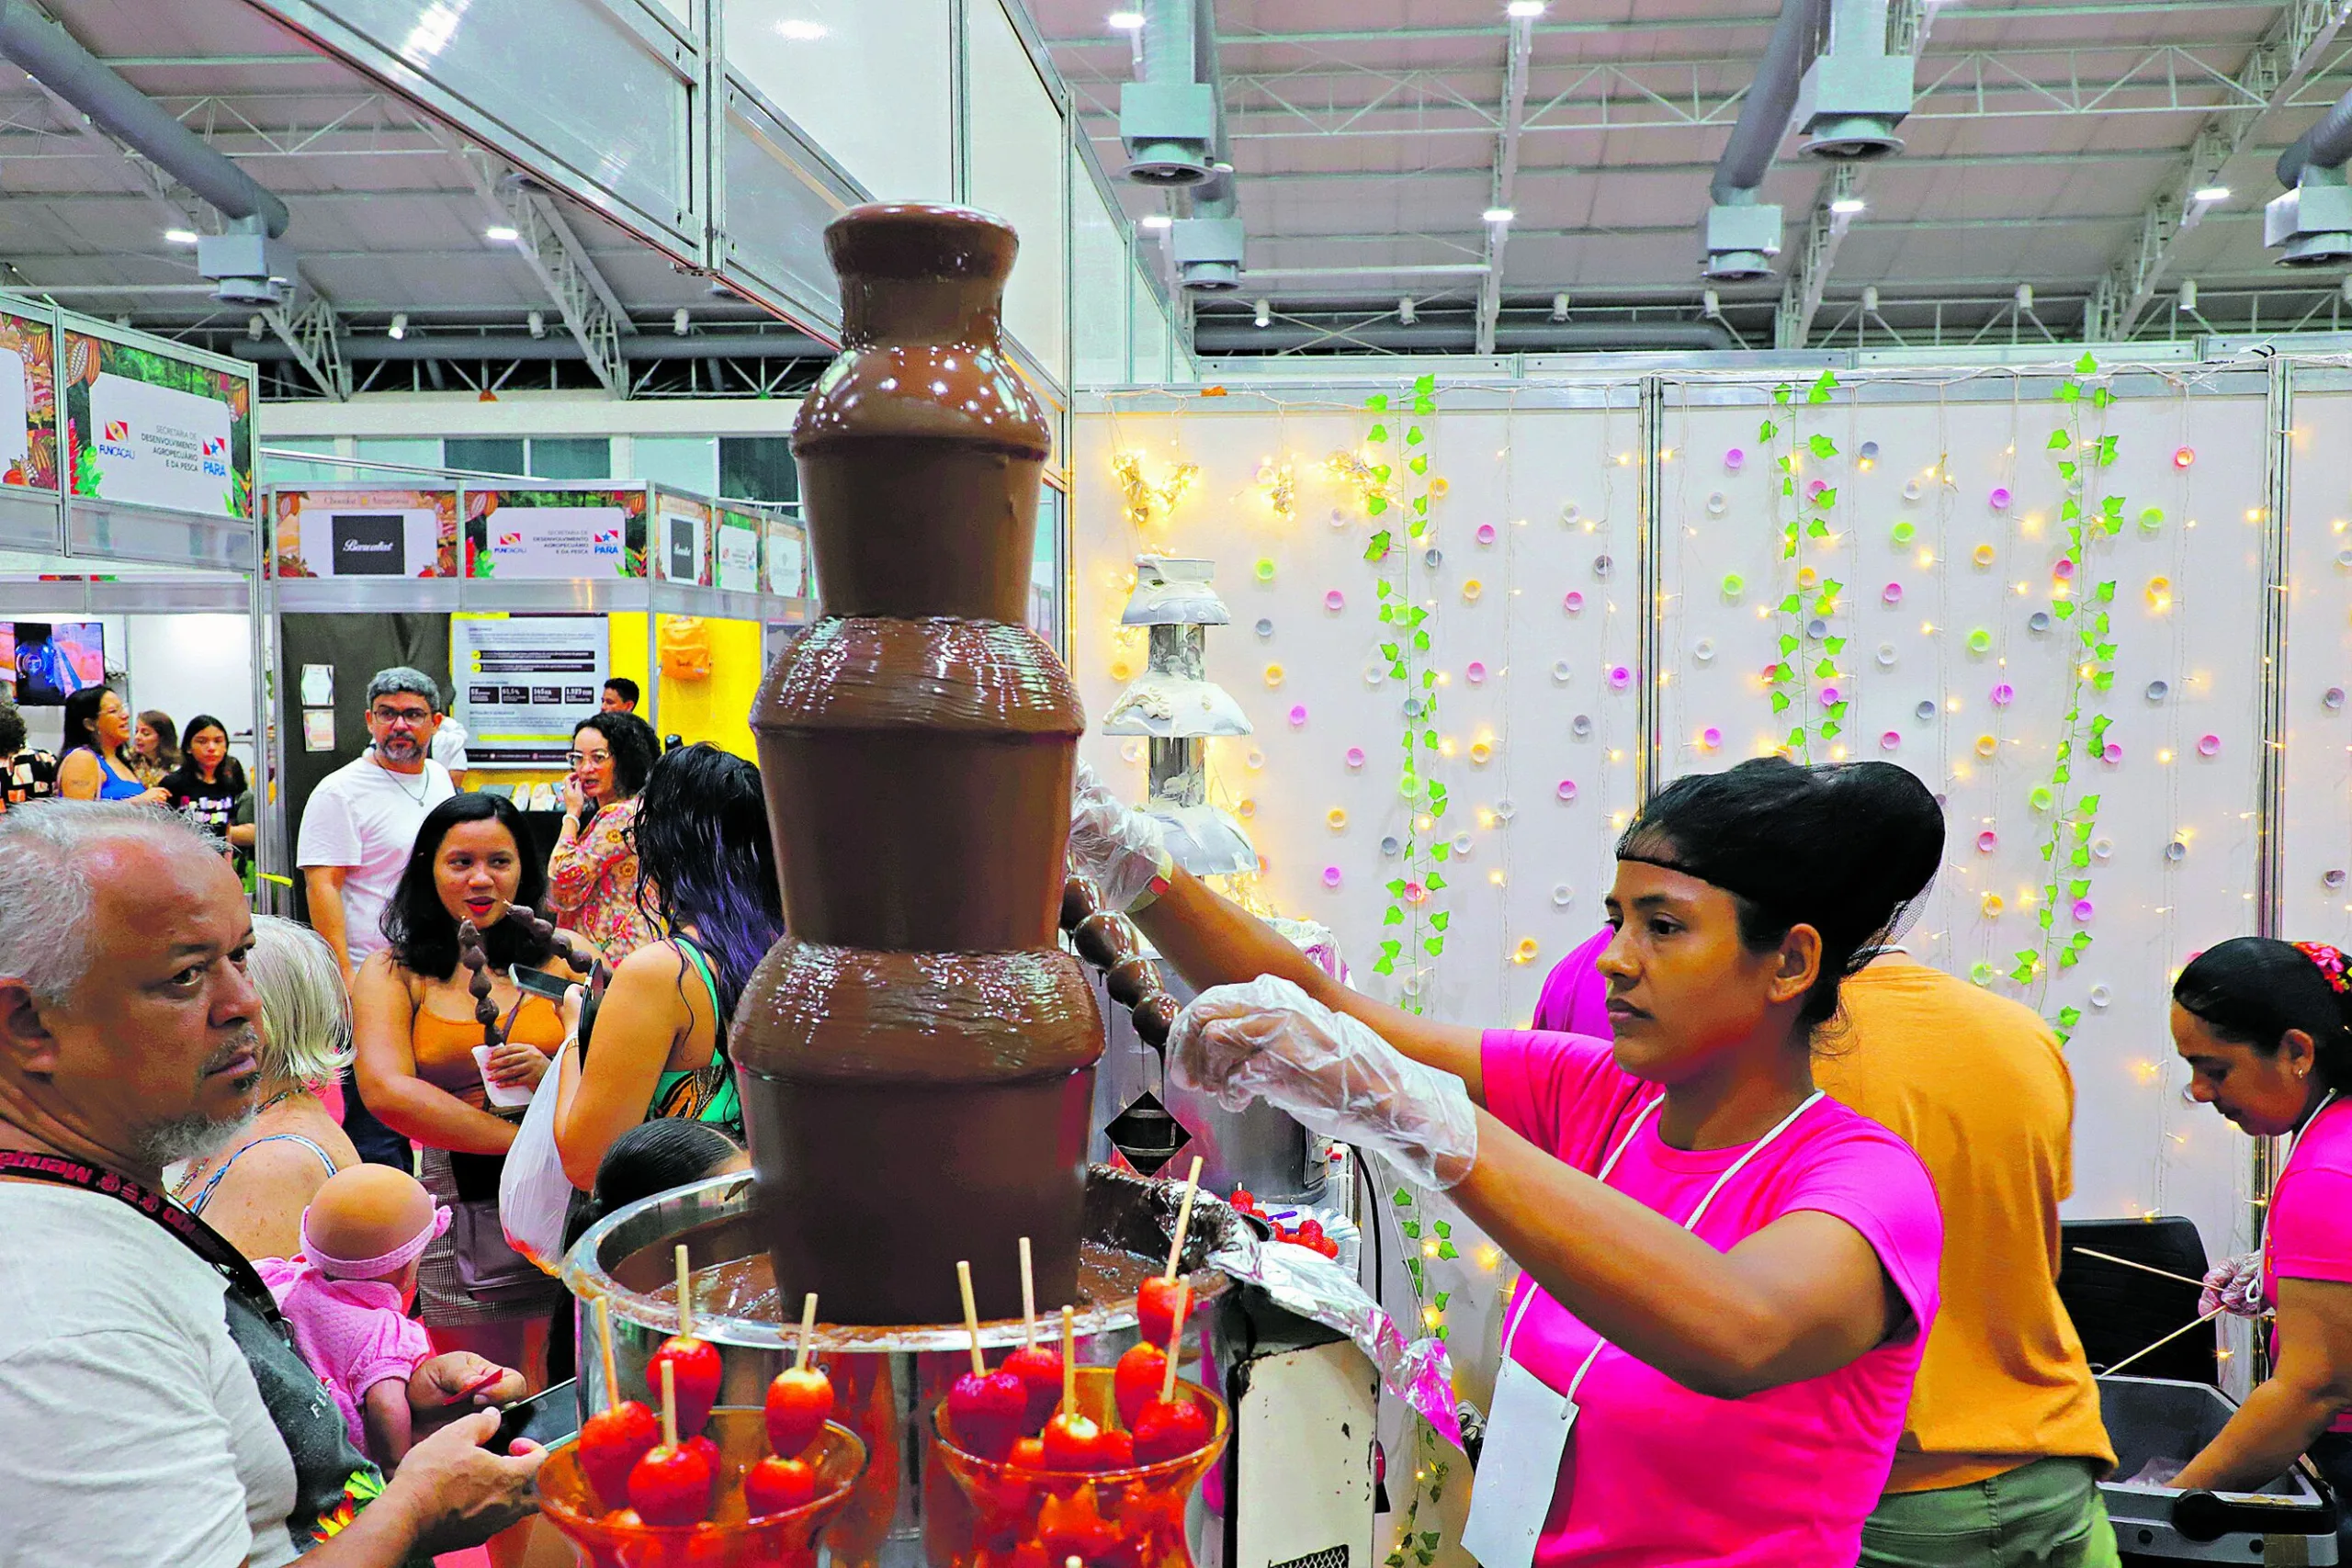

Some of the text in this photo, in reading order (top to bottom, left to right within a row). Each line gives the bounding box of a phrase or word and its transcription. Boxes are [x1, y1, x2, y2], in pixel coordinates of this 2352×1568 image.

[141, 434, 198, 451] DESENVOLVIMENTO
[171, 460, 179, 468] DA
[181, 462, 198, 472] PESCA
